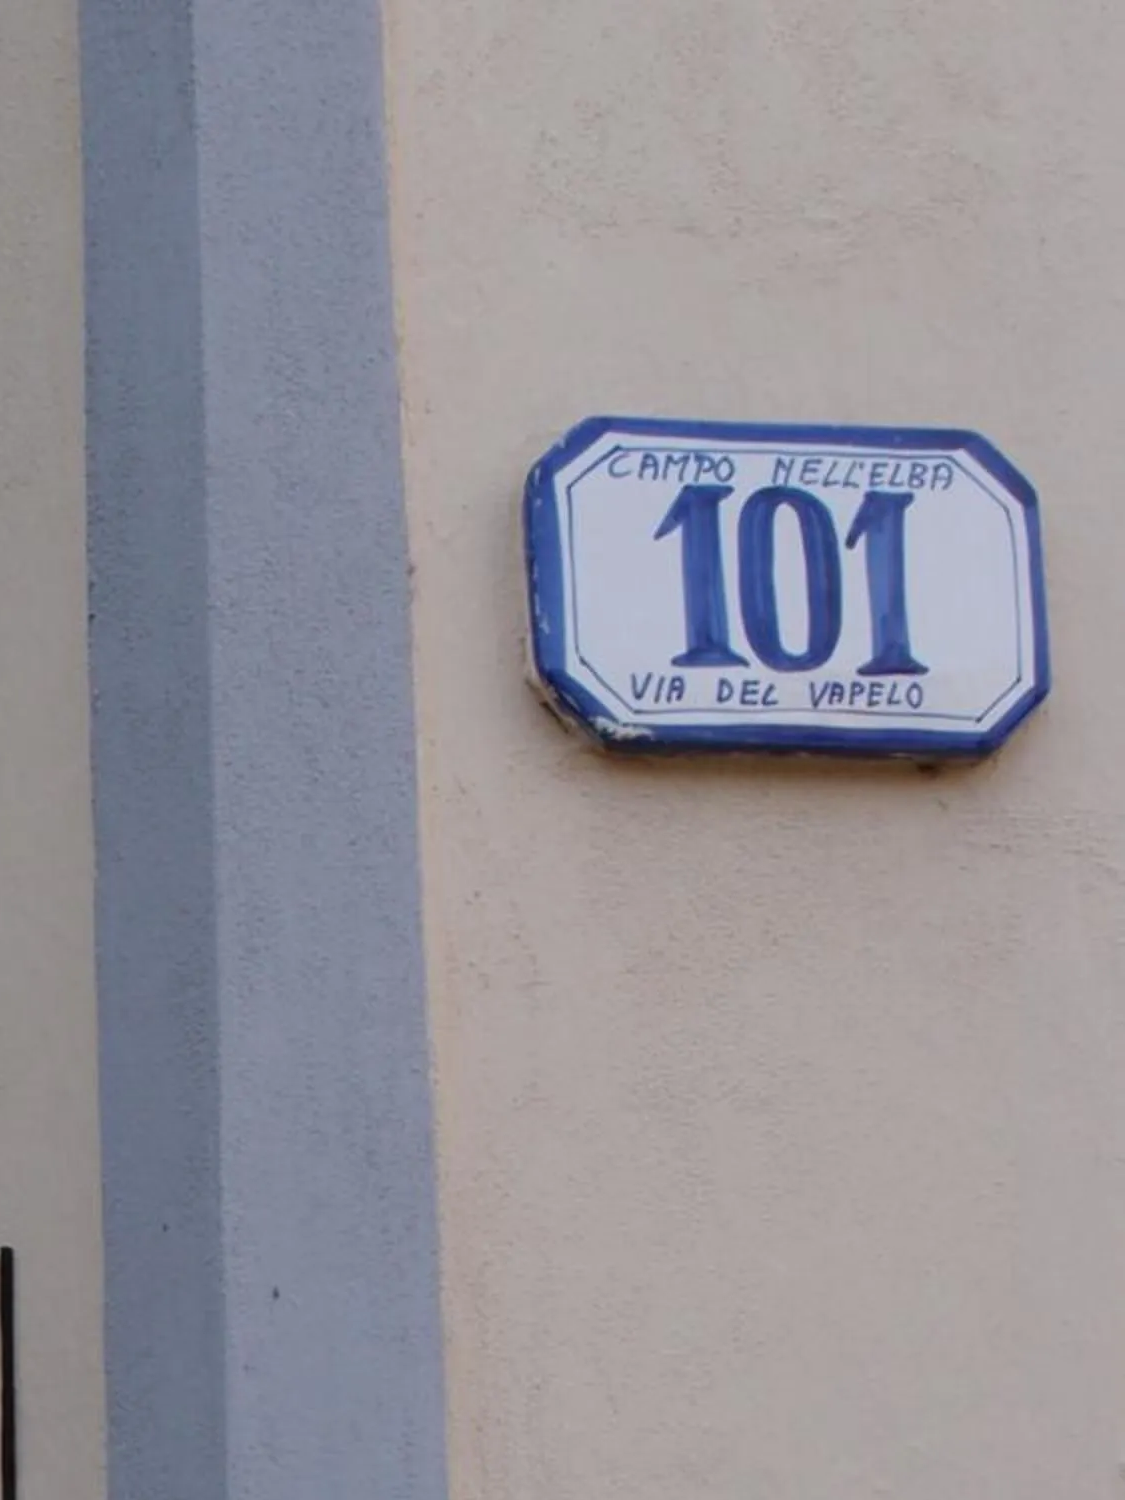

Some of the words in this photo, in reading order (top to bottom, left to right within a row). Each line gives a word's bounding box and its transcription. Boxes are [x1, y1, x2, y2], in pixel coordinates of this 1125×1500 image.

[607, 451, 736, 484] CAMPO
[771, 456, 956, 492] NELL'ELBA
[653, 484, 930, 675] 101
[630, 672, 686, 705] VIA
[716, 676, 779, 707] DEL
[809, 680, 924, 710] VAPELO
